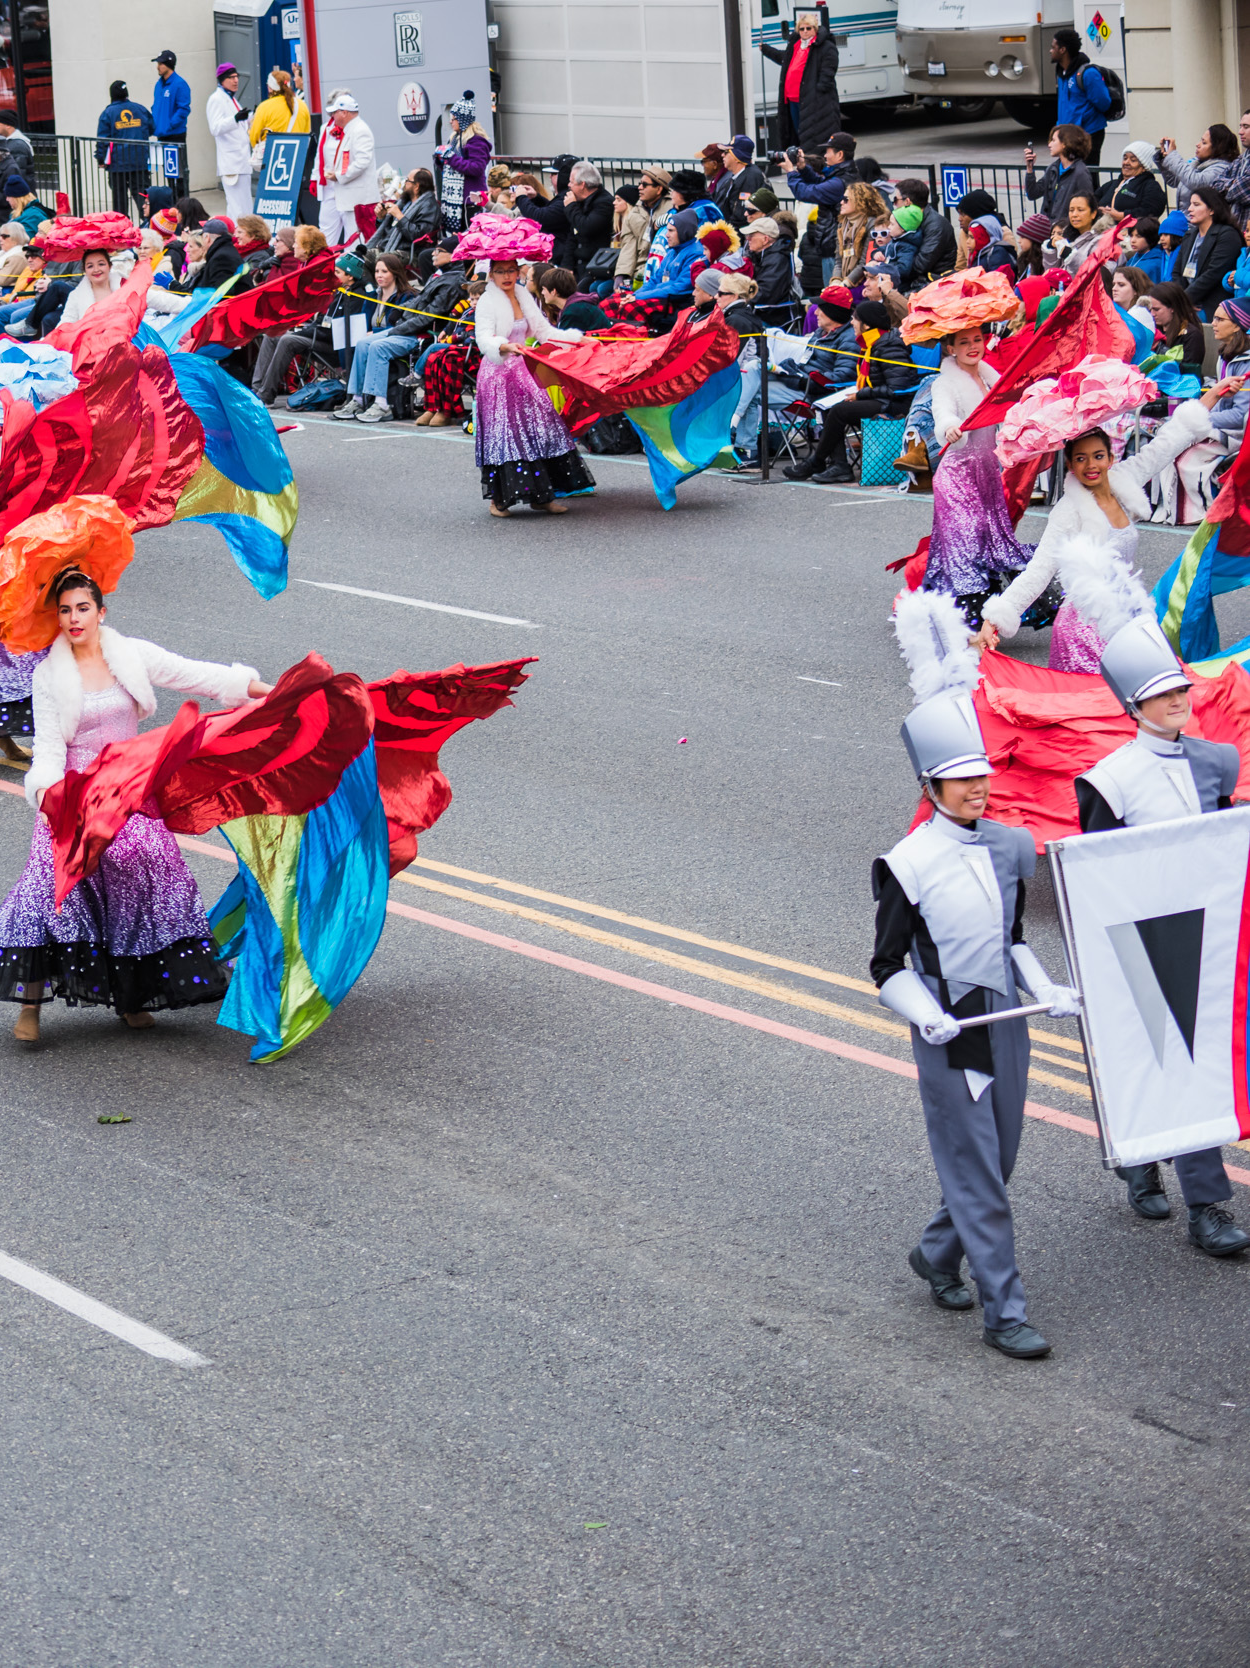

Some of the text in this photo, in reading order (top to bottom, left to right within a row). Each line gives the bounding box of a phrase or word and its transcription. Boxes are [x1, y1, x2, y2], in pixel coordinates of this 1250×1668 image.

[1096, 13, 1101, 26] 2
[1090, 24, 1095, 36] 2
[1101, 25, 1108, 37] 0
[400, 56, 422, 64] ROYCE
